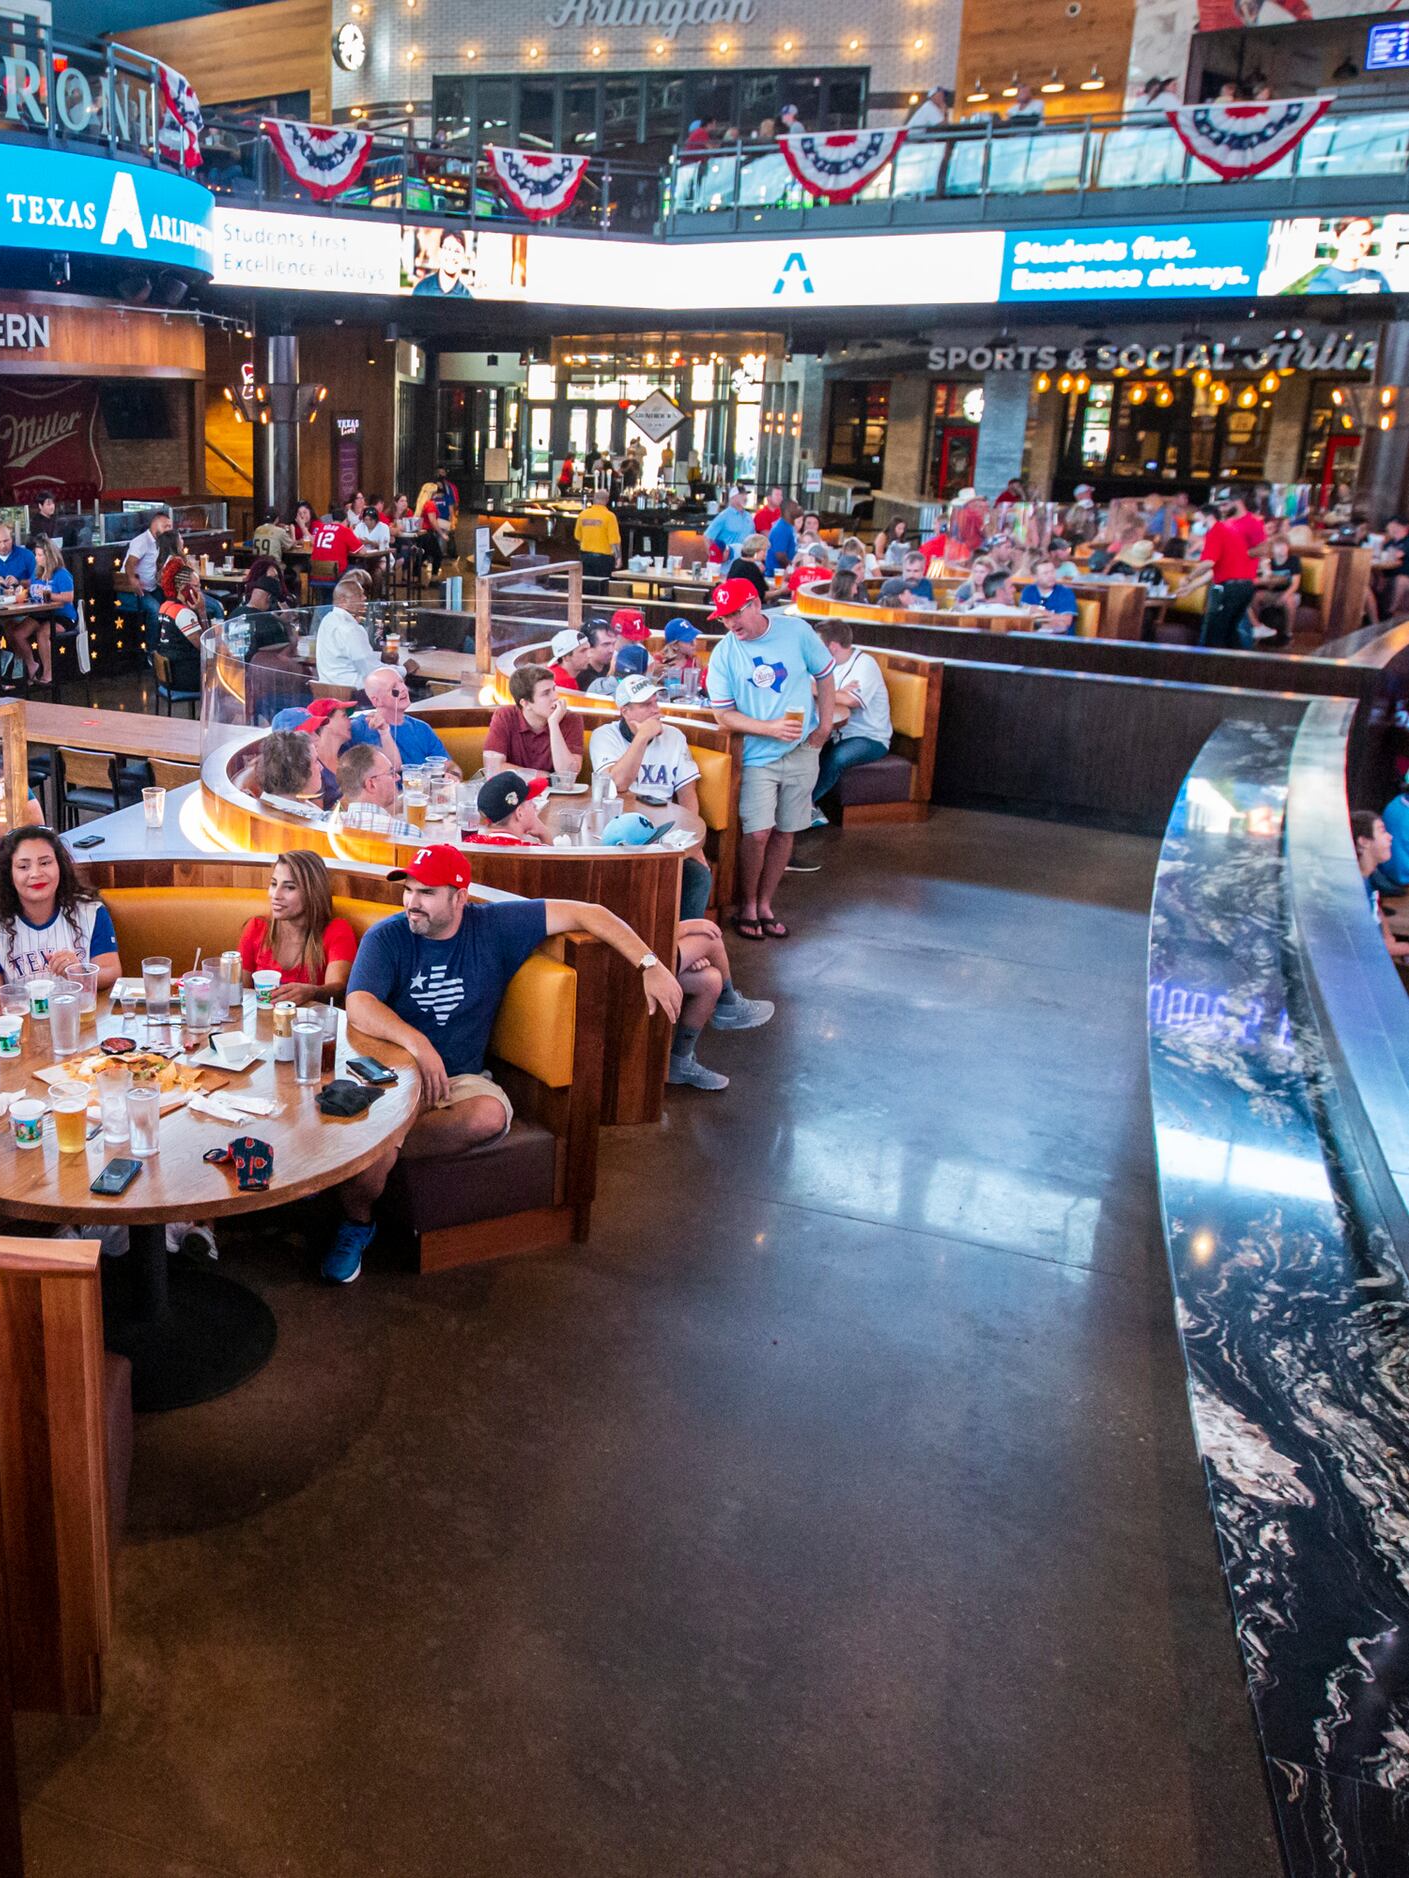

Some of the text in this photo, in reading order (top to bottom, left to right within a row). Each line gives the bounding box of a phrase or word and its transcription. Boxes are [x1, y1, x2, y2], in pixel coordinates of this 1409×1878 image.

[546, 0, 756, 42] Arlington
[6, 191, 96, 231] TEXAS
[223, 223, 348, 251] Students first
[1014, 239, 1127, 264] Students
[223, 252, 316, 278] Excellence
[1011, 266, 1143, 291] Excellence
[927, 346, 1057, 371] SPORTS
[1067, 346, 1088, 371] &
[1096, 344, 1235, 371] SOCIAL
[254, 538, 270, 557] 59
[316, 531, 335, 549] 12
[413, 849, 432, 865] T
